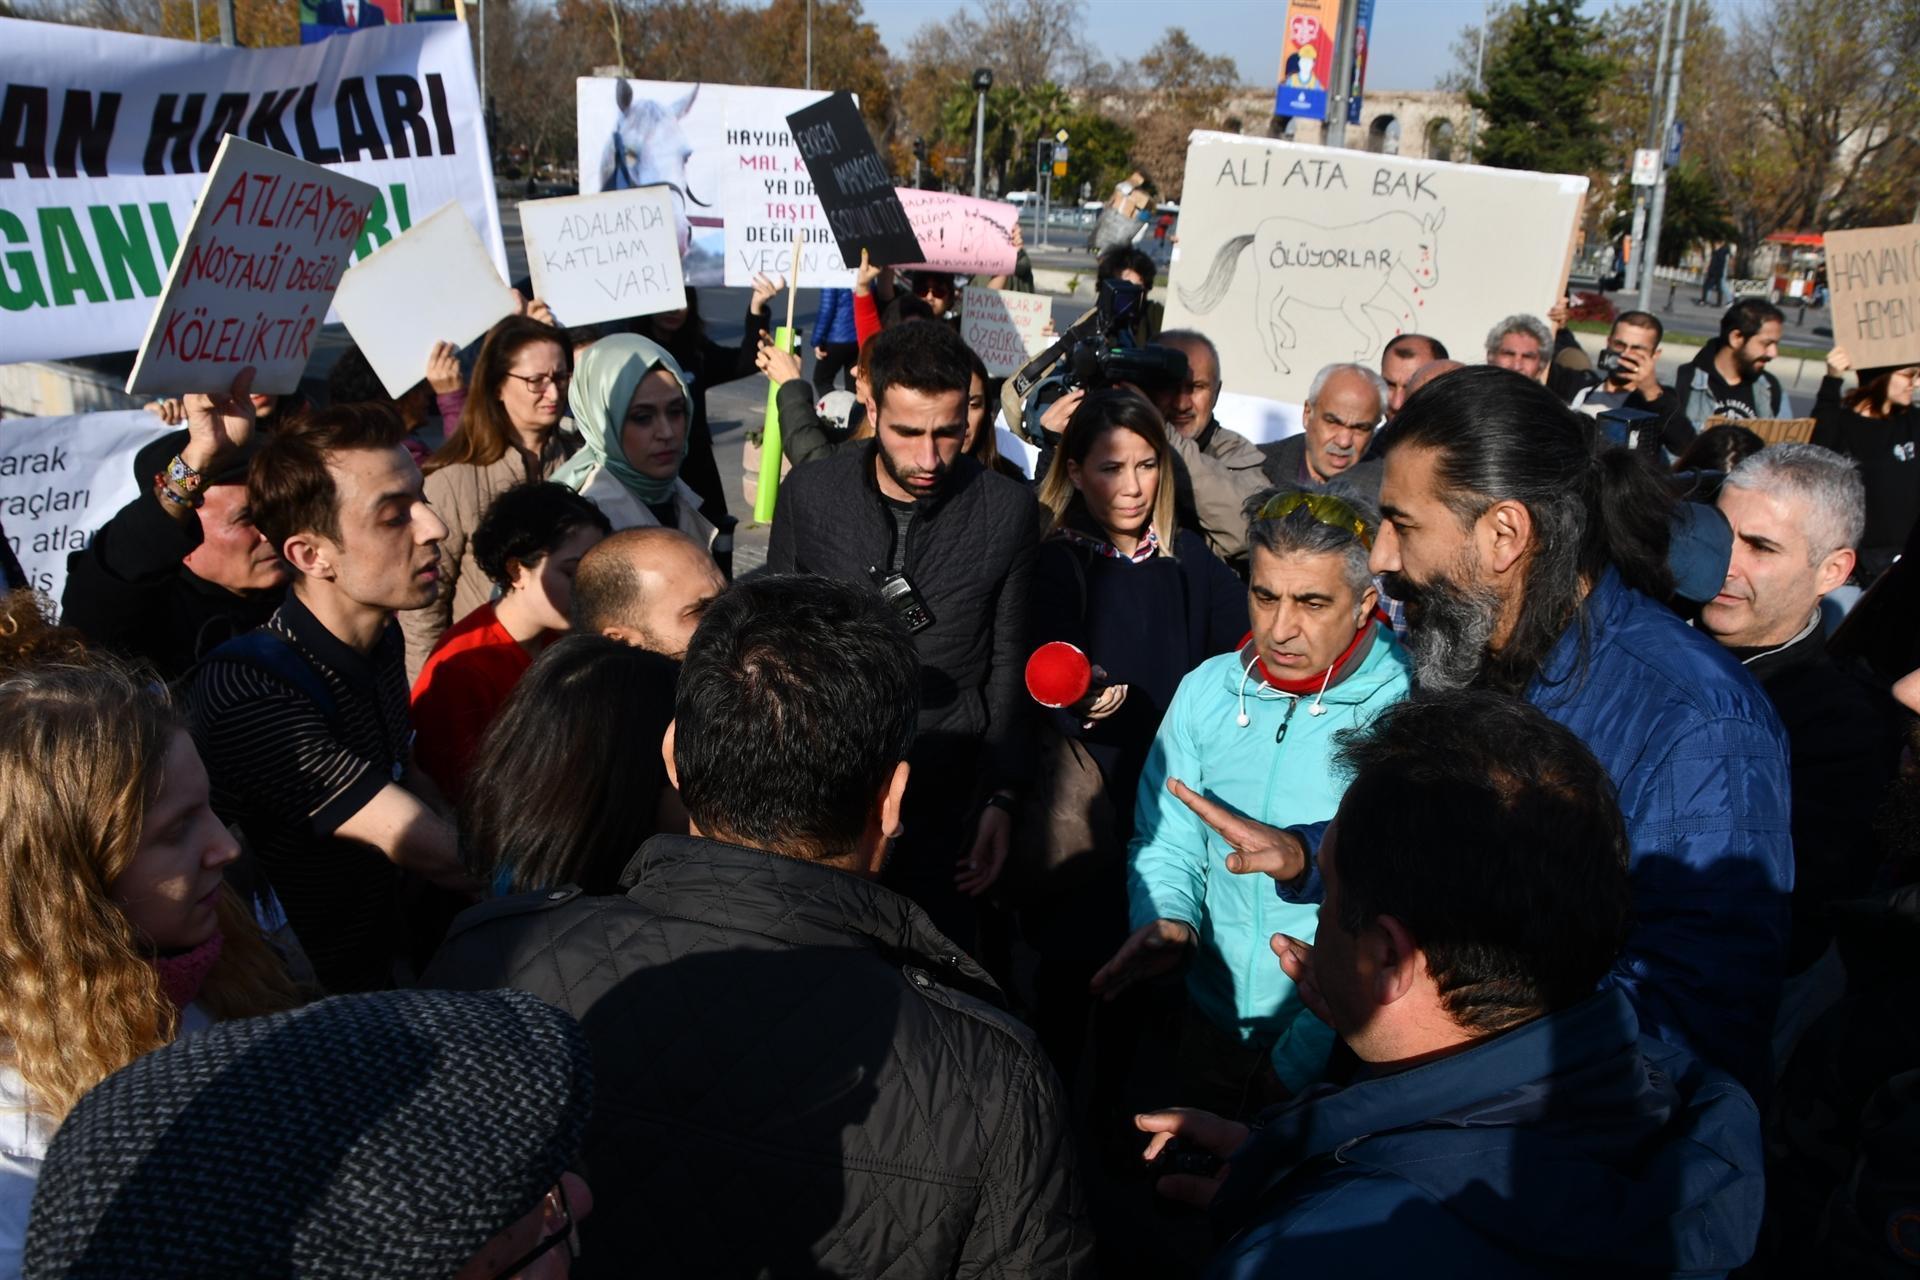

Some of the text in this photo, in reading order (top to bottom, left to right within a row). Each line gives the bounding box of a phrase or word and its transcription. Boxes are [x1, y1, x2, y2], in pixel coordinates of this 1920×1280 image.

[143, 73, 456, 176] HAKLARI
[727, 129, 797, 147] HAYVA
[764, 178, 818, 196] YA DA
[1216, 149, 1438, 202] ALİ ATA BAK
[766, 202, 817, 223] TAŞIT
[286, 254, 337, 293] DEĞİL
[1269, 240, 1393, 269] ÖLÜYORLAR
[1831, 247, 1909, 293] HAYVAN
[594, 263, 672, 301] VAR!
[156, 304, 317, 363] KÖLELİKTİR
[1854, 296, 1914, 340] HEMEN
[0, 445, 68, 476] arak
